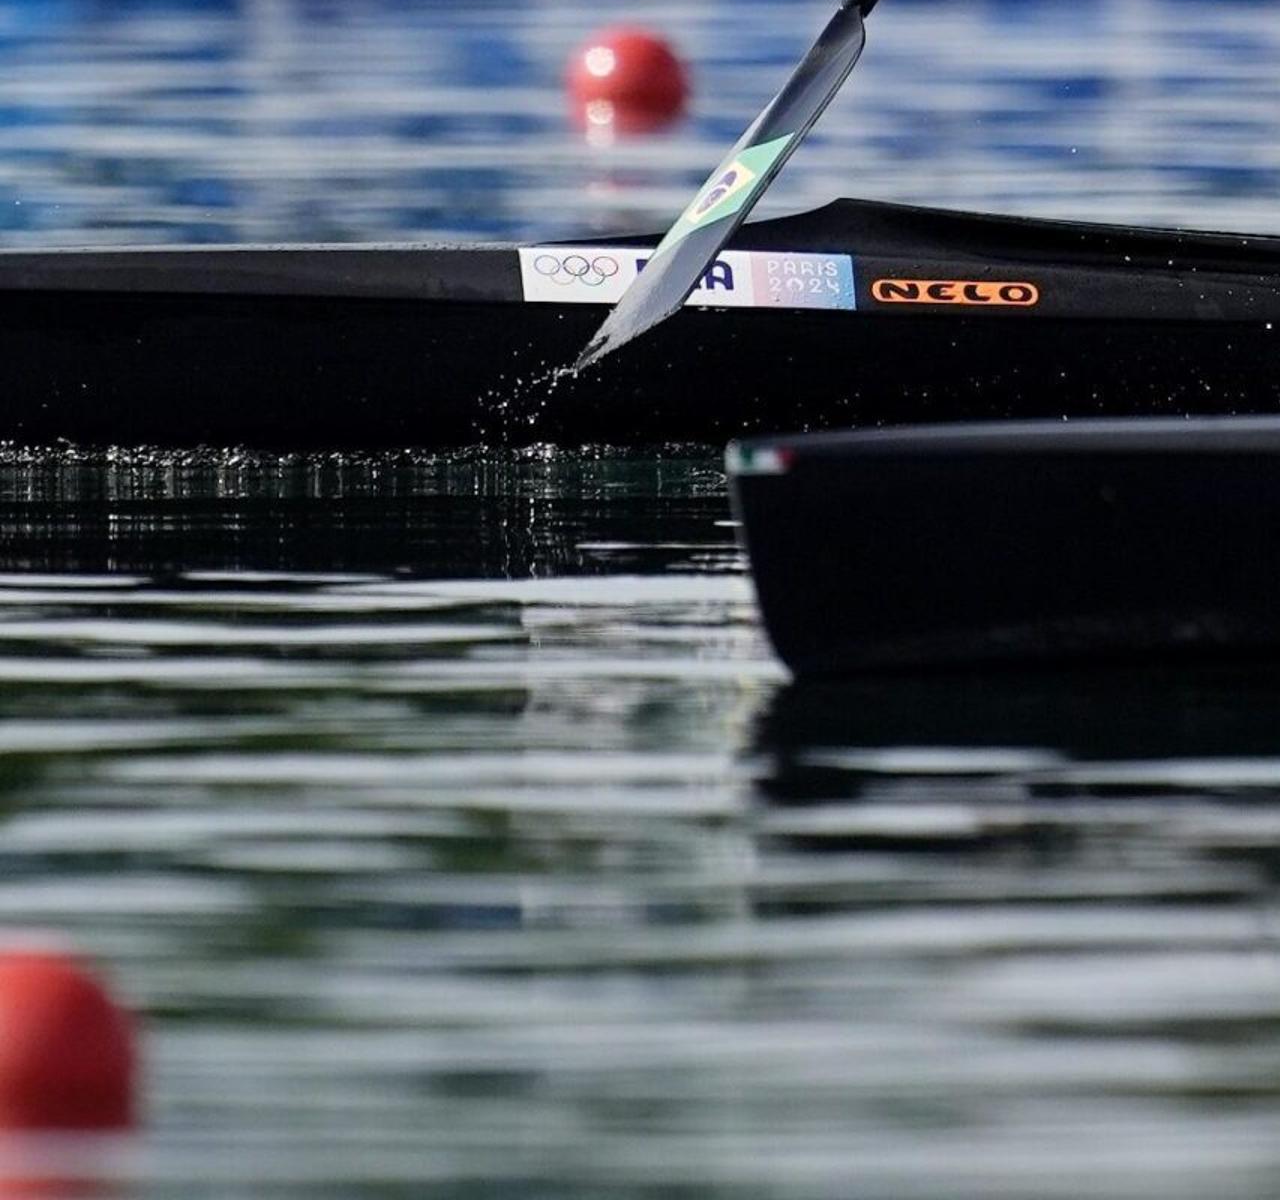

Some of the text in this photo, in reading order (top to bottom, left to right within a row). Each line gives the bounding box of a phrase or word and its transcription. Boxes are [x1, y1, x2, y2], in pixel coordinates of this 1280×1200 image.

[767, 259, 839, 277] PARIS
[769, 278, 840, 295] 2024
[879, 282, 1033, 303] NELO
